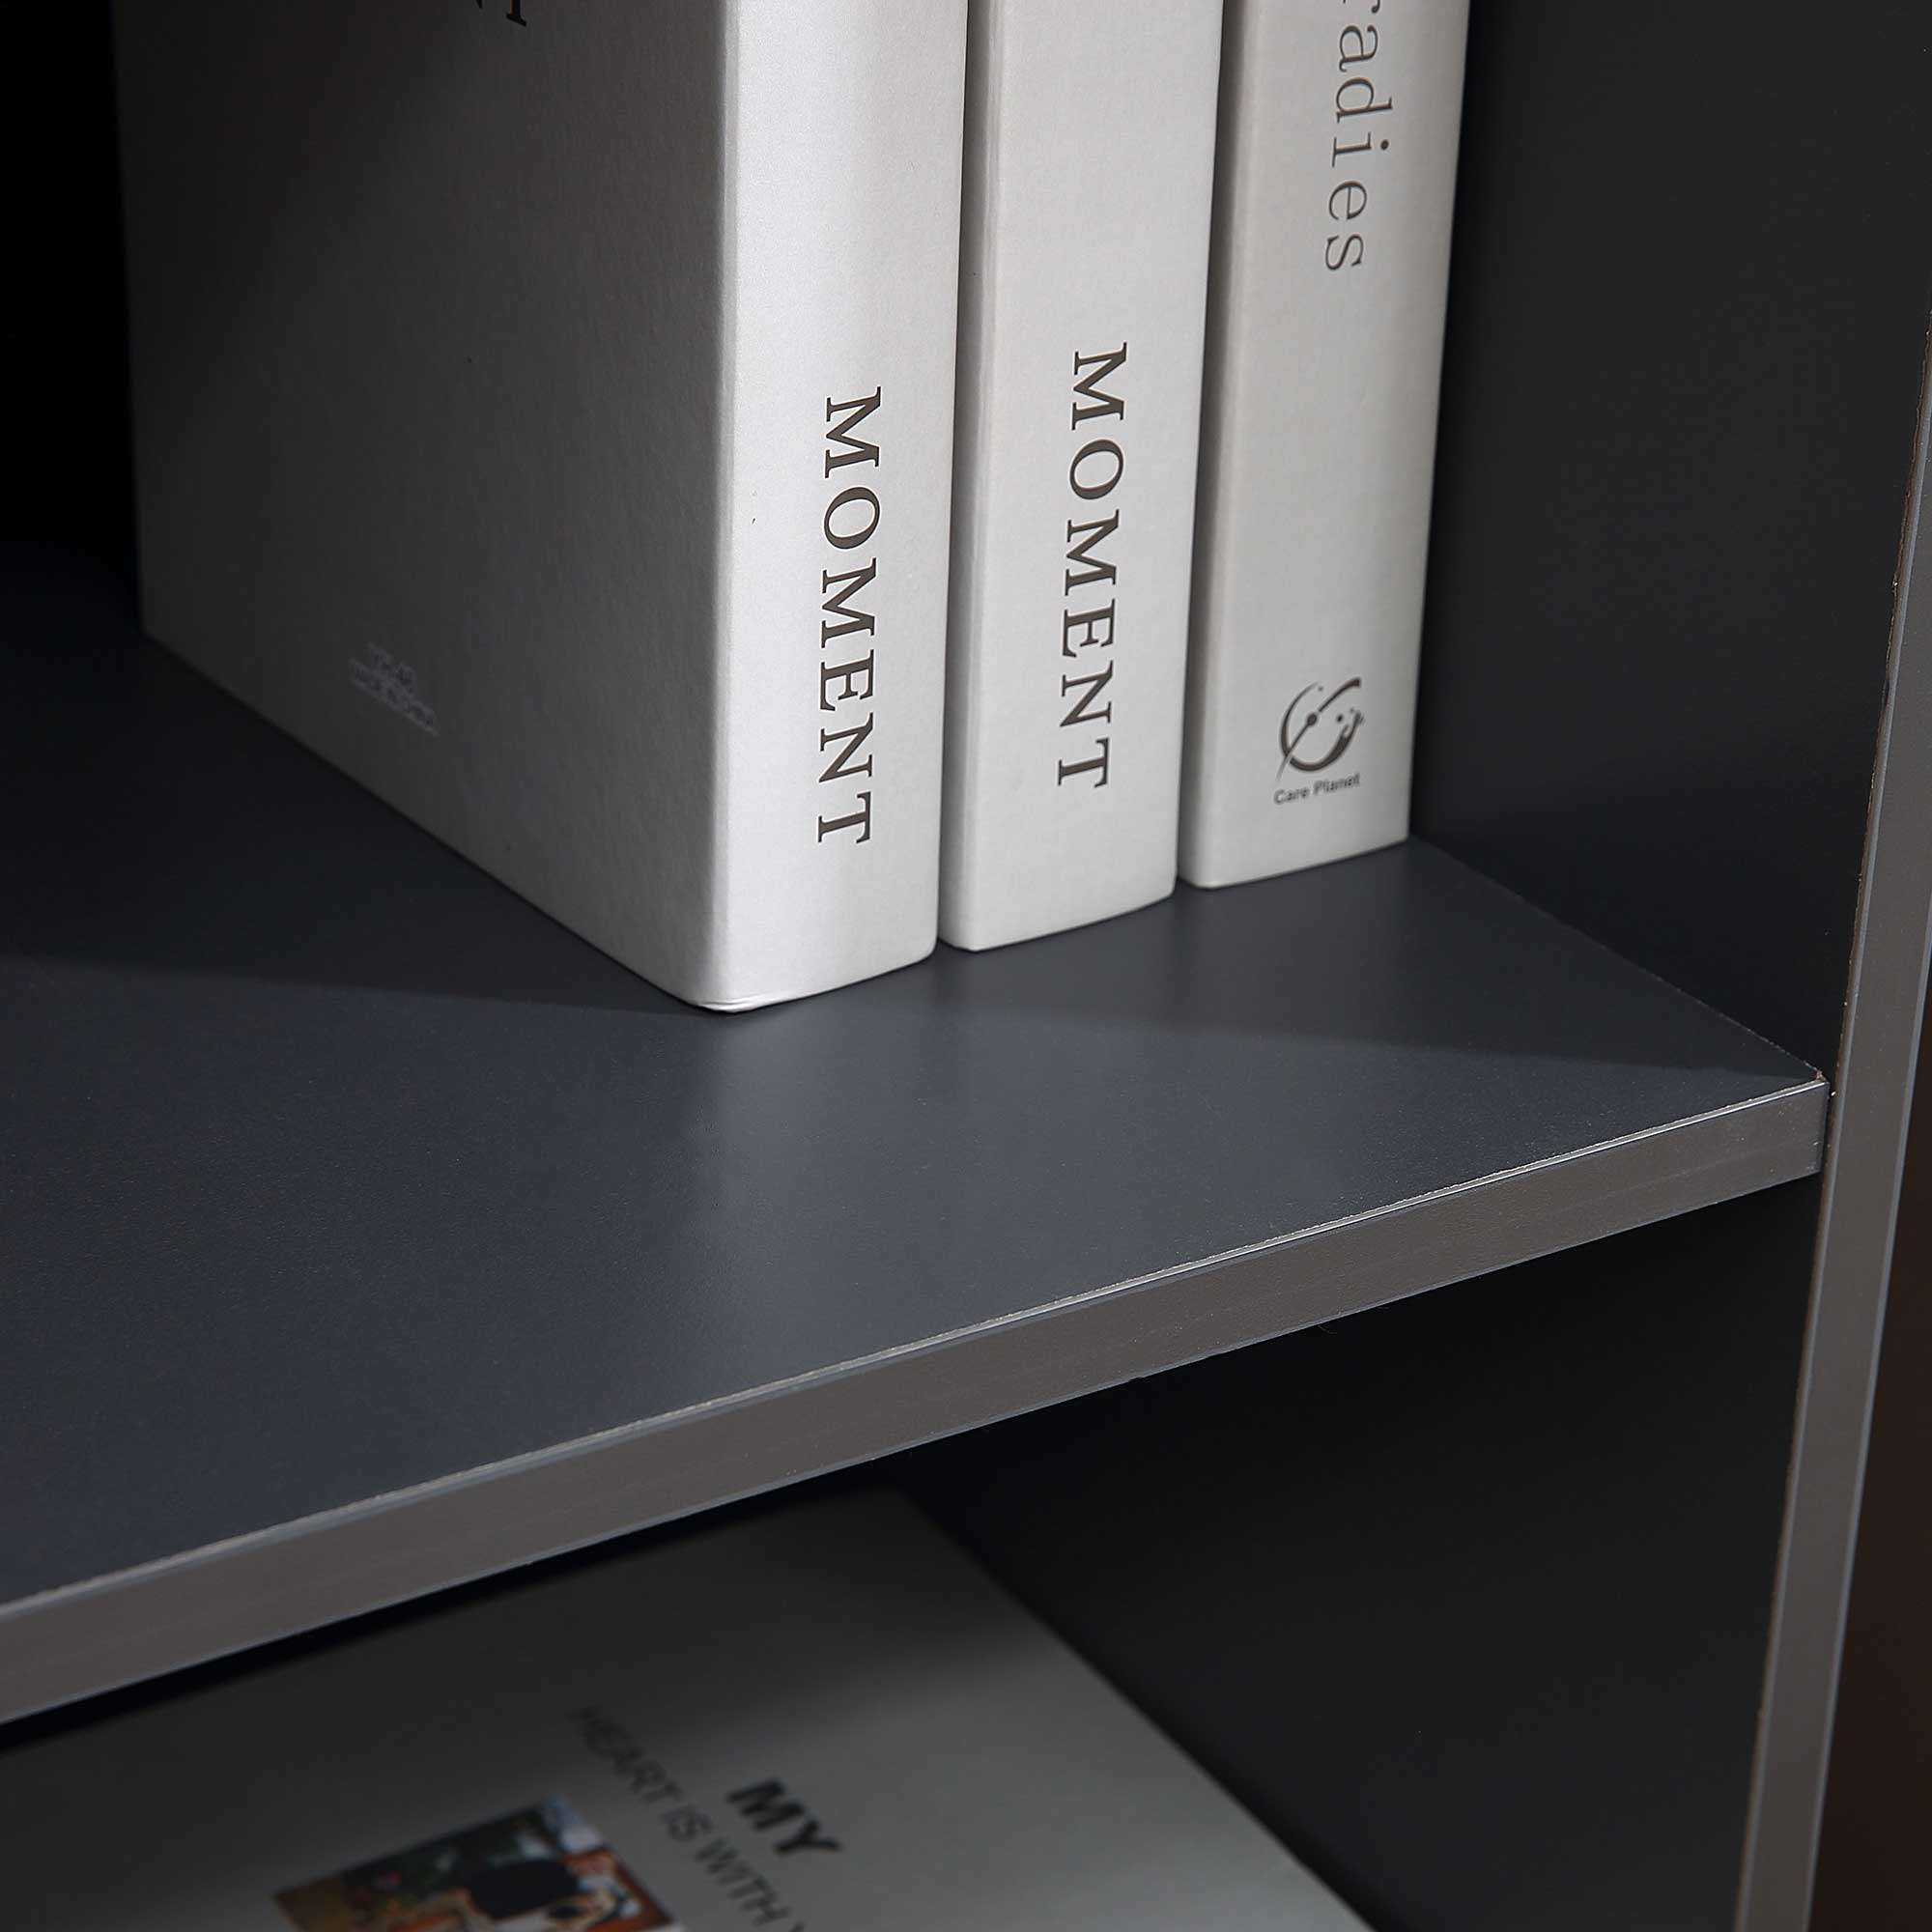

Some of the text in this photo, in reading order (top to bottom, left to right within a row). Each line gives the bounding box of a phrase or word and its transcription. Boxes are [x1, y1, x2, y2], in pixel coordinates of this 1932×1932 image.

[817, 385, 882, 844] MOMENT
[1057, 342, 1128, 788] MOMENT
[1273, 772, 1361, 805] Care Planet
[727, 1777, 840, 1855] MY
